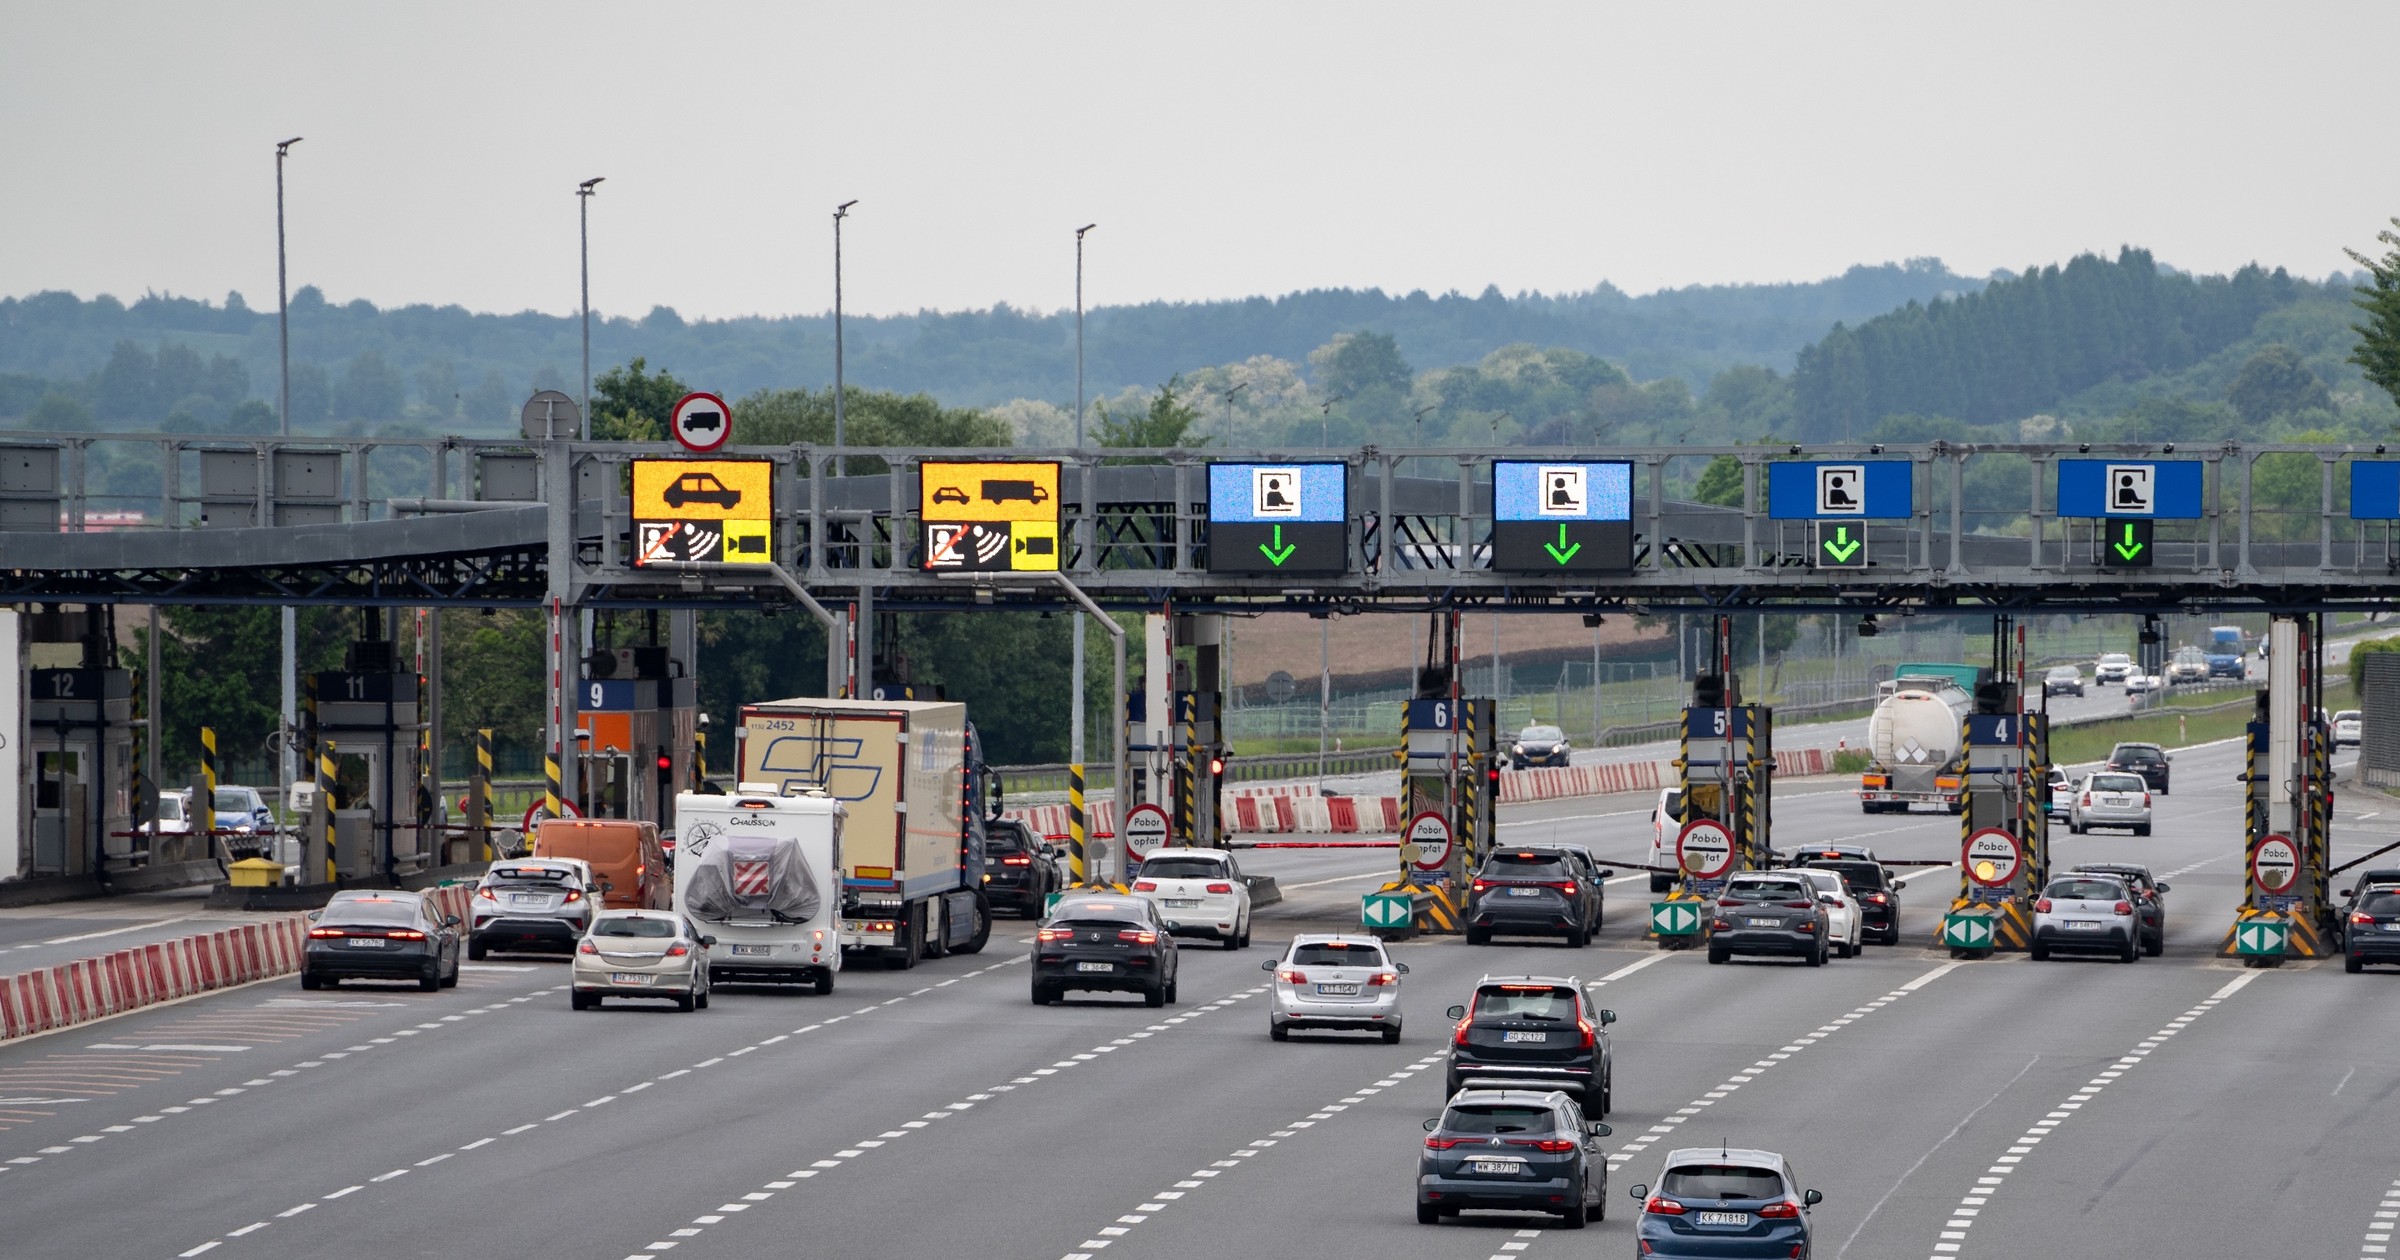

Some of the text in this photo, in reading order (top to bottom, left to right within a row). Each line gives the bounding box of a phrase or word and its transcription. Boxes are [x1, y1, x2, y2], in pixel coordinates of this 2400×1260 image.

[52, 673, 74, 697] 12
[345, 675, 364, 699] 11
[590, 682, 603, 708] 9
[1434, 702, 1447, 728] 6
[766, 719, 795, 731] 2452
[1713, 710, 1725, 735] 5
[1994, 718, 2008, 742] 4
[1134, 816, 1160, 827] Pobór
[1417, 824, 1442, 835] Pobór
[1133, 836, 1159, 848] opłat
[1691, 832, 1722, 844] Pobór
[1419, 844, 1441, 855] płat
[1977, 841, 2008, 852] Pobór
[2263, 847, 2289, 858] Pobór
[351, 939, 359, 947] KK
[617, 973, 627, 981] RK
[1508, 1032, 1519, 1040] GD
[1477, 1161, 1488, 1171] WW
[1702, 1212, 1746, 1223] KK 71818
